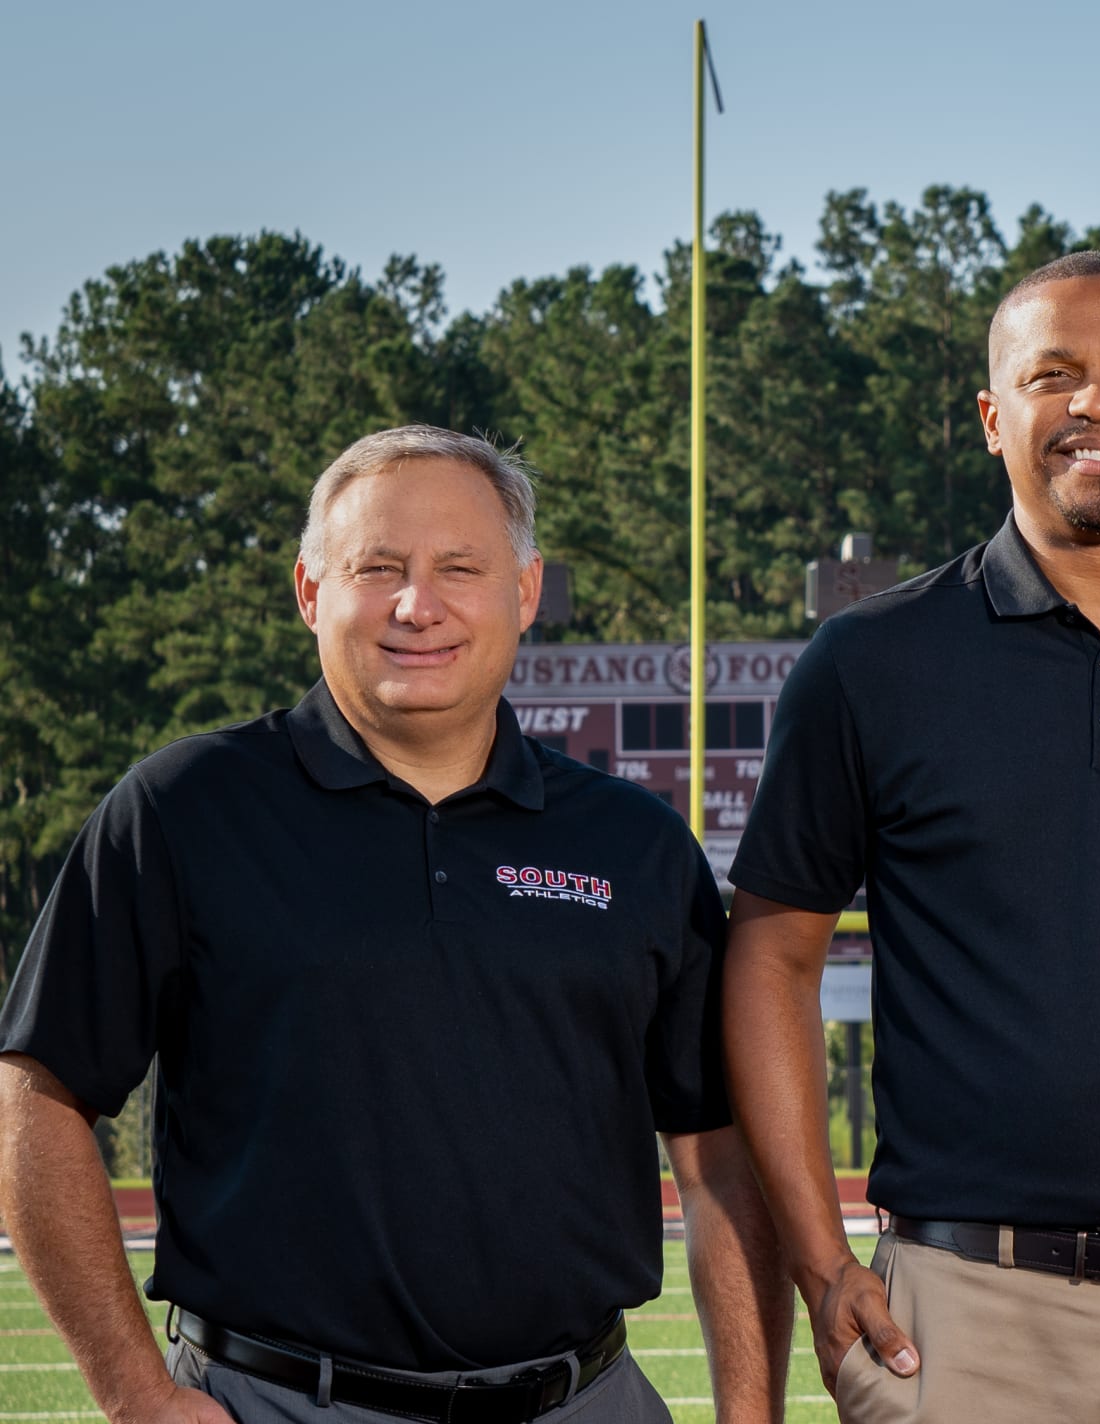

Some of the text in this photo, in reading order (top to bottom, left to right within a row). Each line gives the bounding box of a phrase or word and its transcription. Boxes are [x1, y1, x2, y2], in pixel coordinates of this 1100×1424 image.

[509, 654, 656, 685] USTANG
[728, 654, 797, 682] FOO
[513, 706, 589, 732] UEST
[736, 760, 761, 778] TO
[496, 865, 612, 899] SOUTH
[509, 889, 608, 909] ATHLETICS
